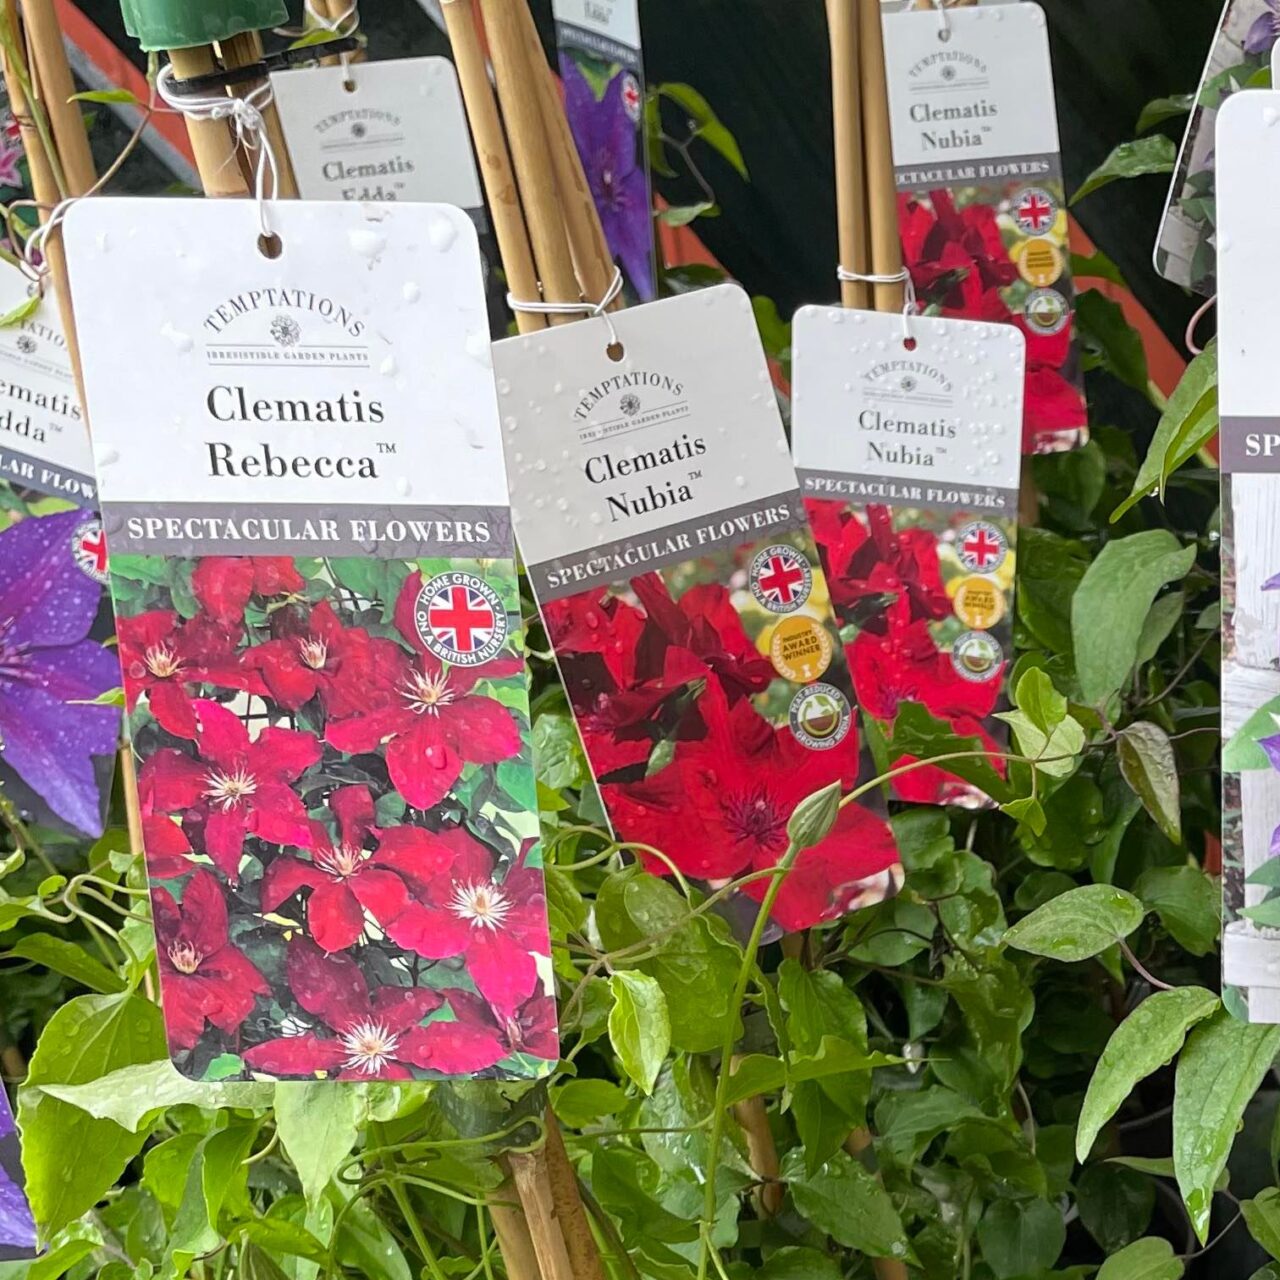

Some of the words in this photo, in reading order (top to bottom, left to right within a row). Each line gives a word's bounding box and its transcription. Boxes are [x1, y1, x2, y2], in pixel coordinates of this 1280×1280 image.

[909, 100, 998, 123] Clematis
[322, 156, 415, 182] Clematis
[979, 161, 1049, 178] FLOWERS
[203, 288, 365, 338] TEMPTATIONS
[206, 350, 280, 360] IRRESISTIBLE
[284, 352, 326, 361] GARDEN
[330, 353, 369, 362] PLANTS
[0, 380, 82, 422] ematis
[207, 385, 385, 423] Clematis
[573, 371, 684, 421] TEMPTATIONS
[859, 409, 957, 439] Clematis
[584, 434, 707, 484] Clematis
[41, 467, 97, 499] FLOW
[805, 477, 922, 500] SPECTACULAR
[926, 488, 1006, 509] FLOWERS
[127, 517, 341, 542] SPECTACULAR
[350, 519, 491, 544] FLOWERS
[546, 533, 692, 589] SPECTACULAR
[696, 503, 792, 545] FLOWERS
[420, 575, 450, 605] HOME
[453, 573, 499, 605] GROWN
[417, 611, 429, 632] ON
[424, 635, 434, 645] A
[433, 644, 477, 664] BRITISH
[477, 611, 505, 660] NURSERY
[783, 635, 818, 653] AWARD
[783, 644, 821, 662] WINNER
